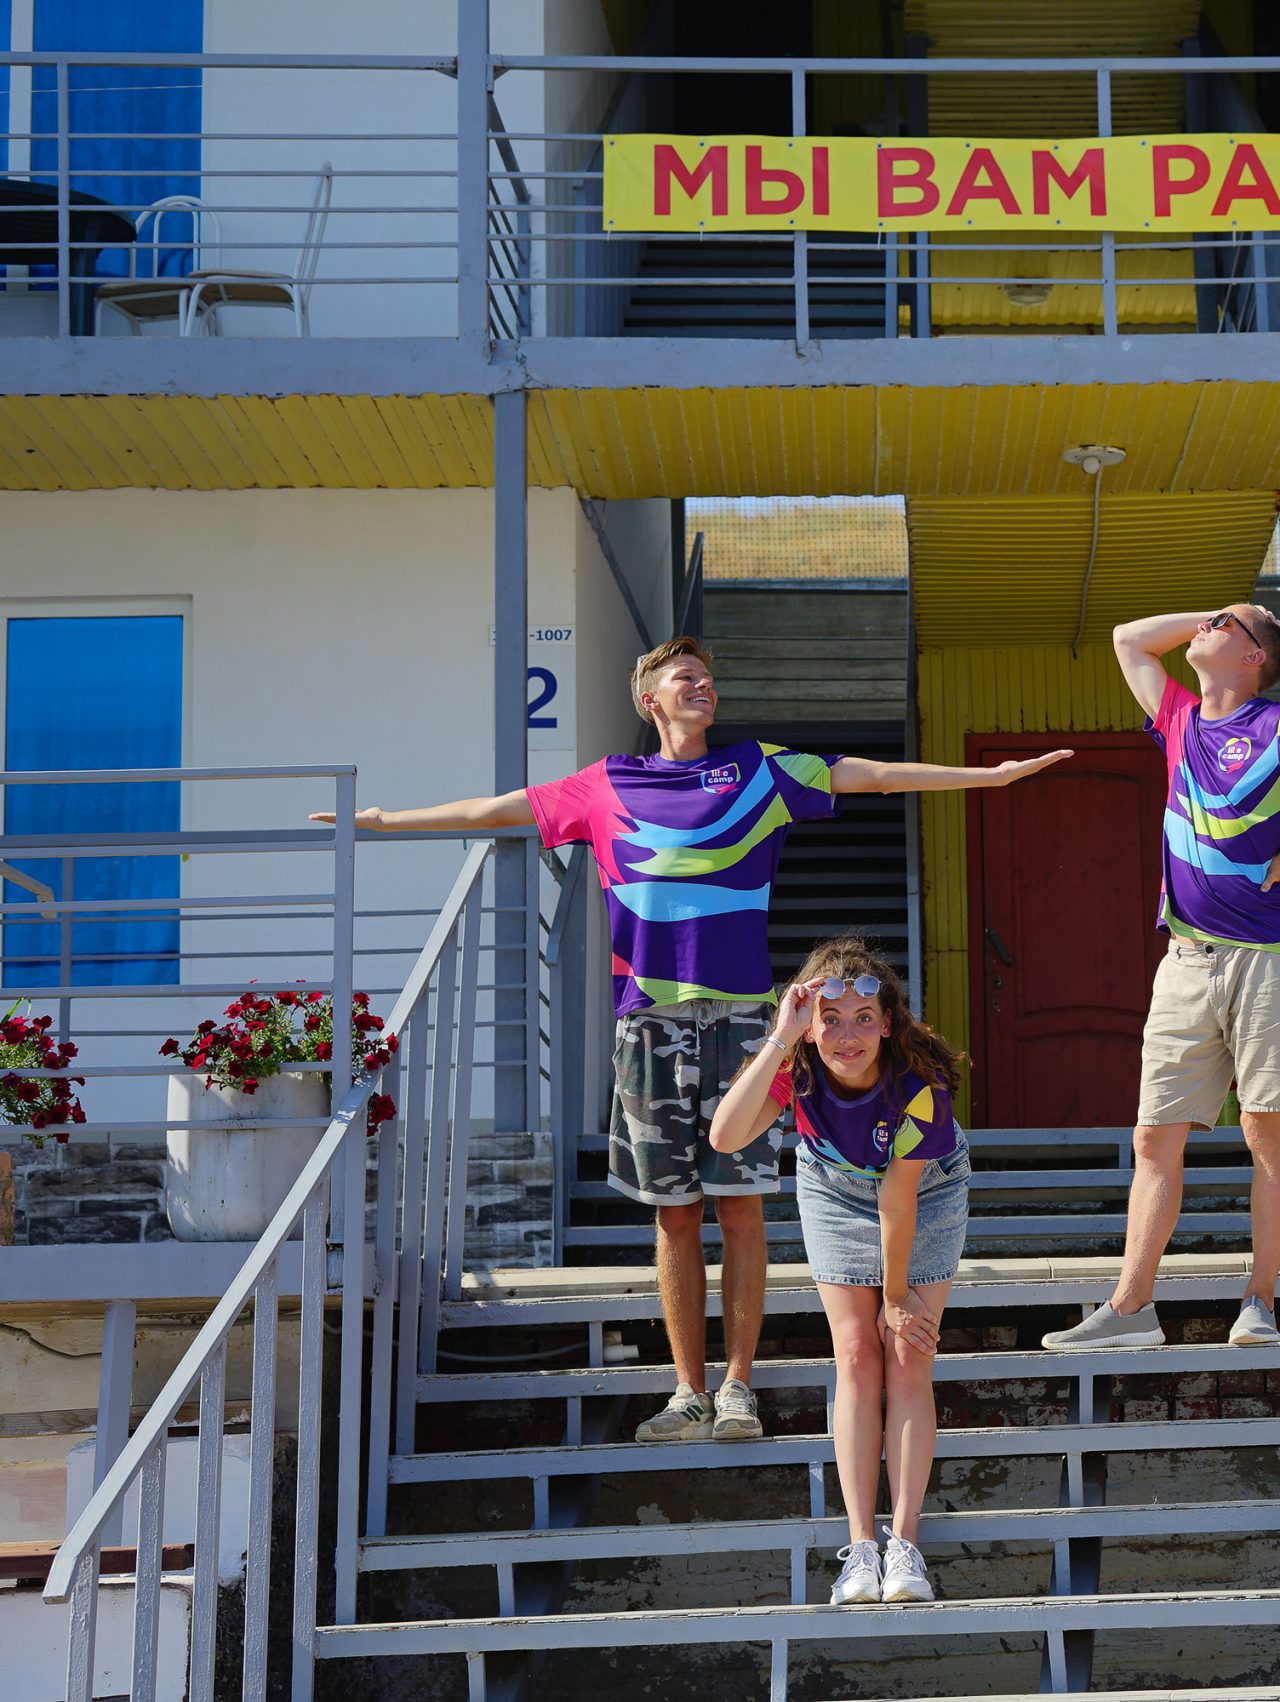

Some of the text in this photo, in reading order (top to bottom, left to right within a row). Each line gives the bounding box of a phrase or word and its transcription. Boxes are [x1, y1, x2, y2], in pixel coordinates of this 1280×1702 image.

[654, 144, 830, 216] МЫ
[877, 147, 1107, 218] ВАМ
[527, 666, 557, 729] 2
[707, 776, 734, 784] camp
